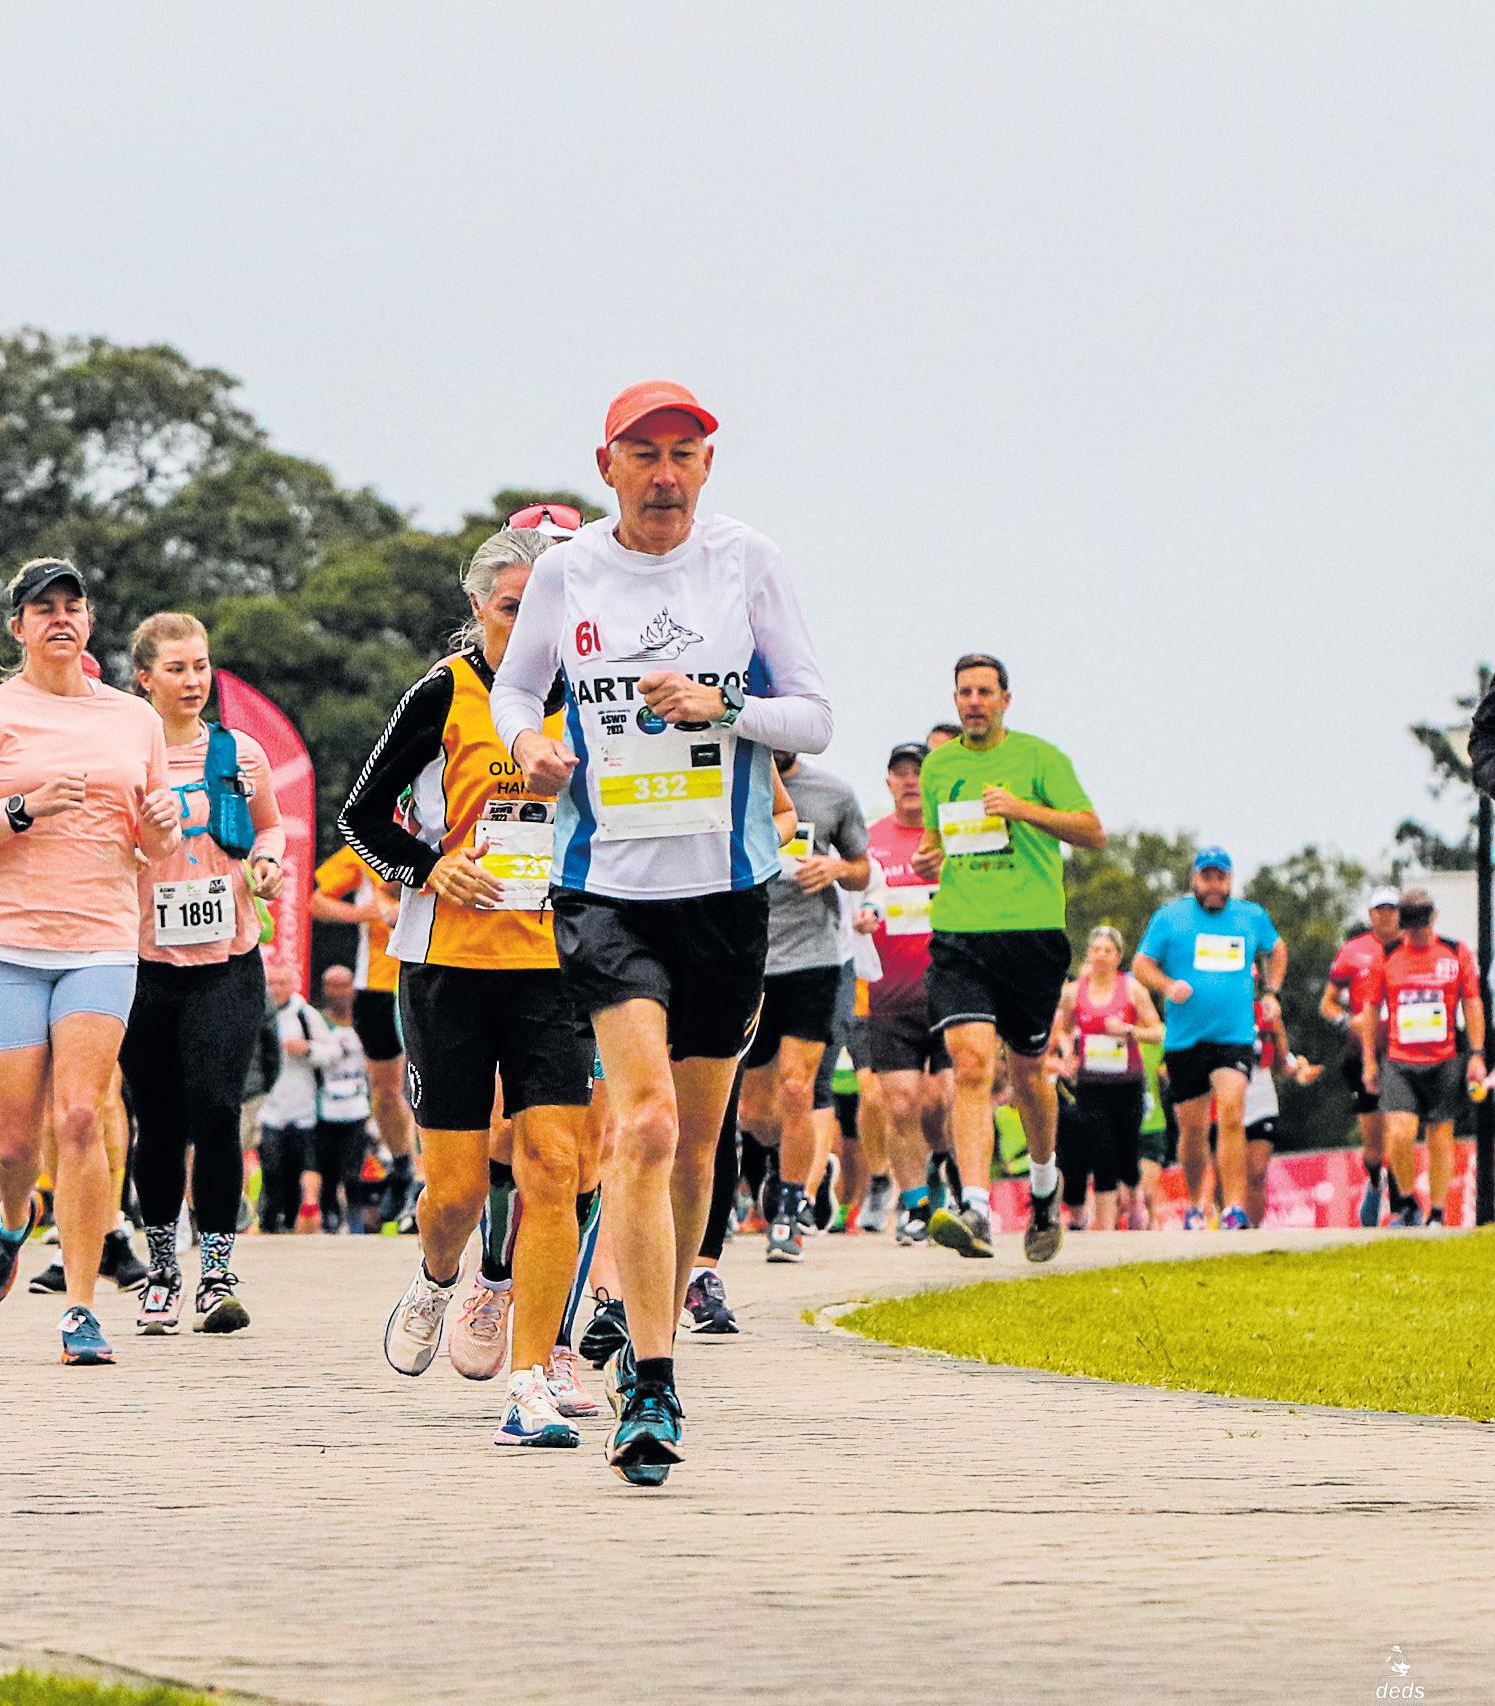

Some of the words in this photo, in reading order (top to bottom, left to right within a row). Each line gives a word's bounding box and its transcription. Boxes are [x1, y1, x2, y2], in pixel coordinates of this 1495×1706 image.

[633, 774, 689, 801] 332
[156, 904, 168, 928] T
[178, 899, 223, 927] 1891
